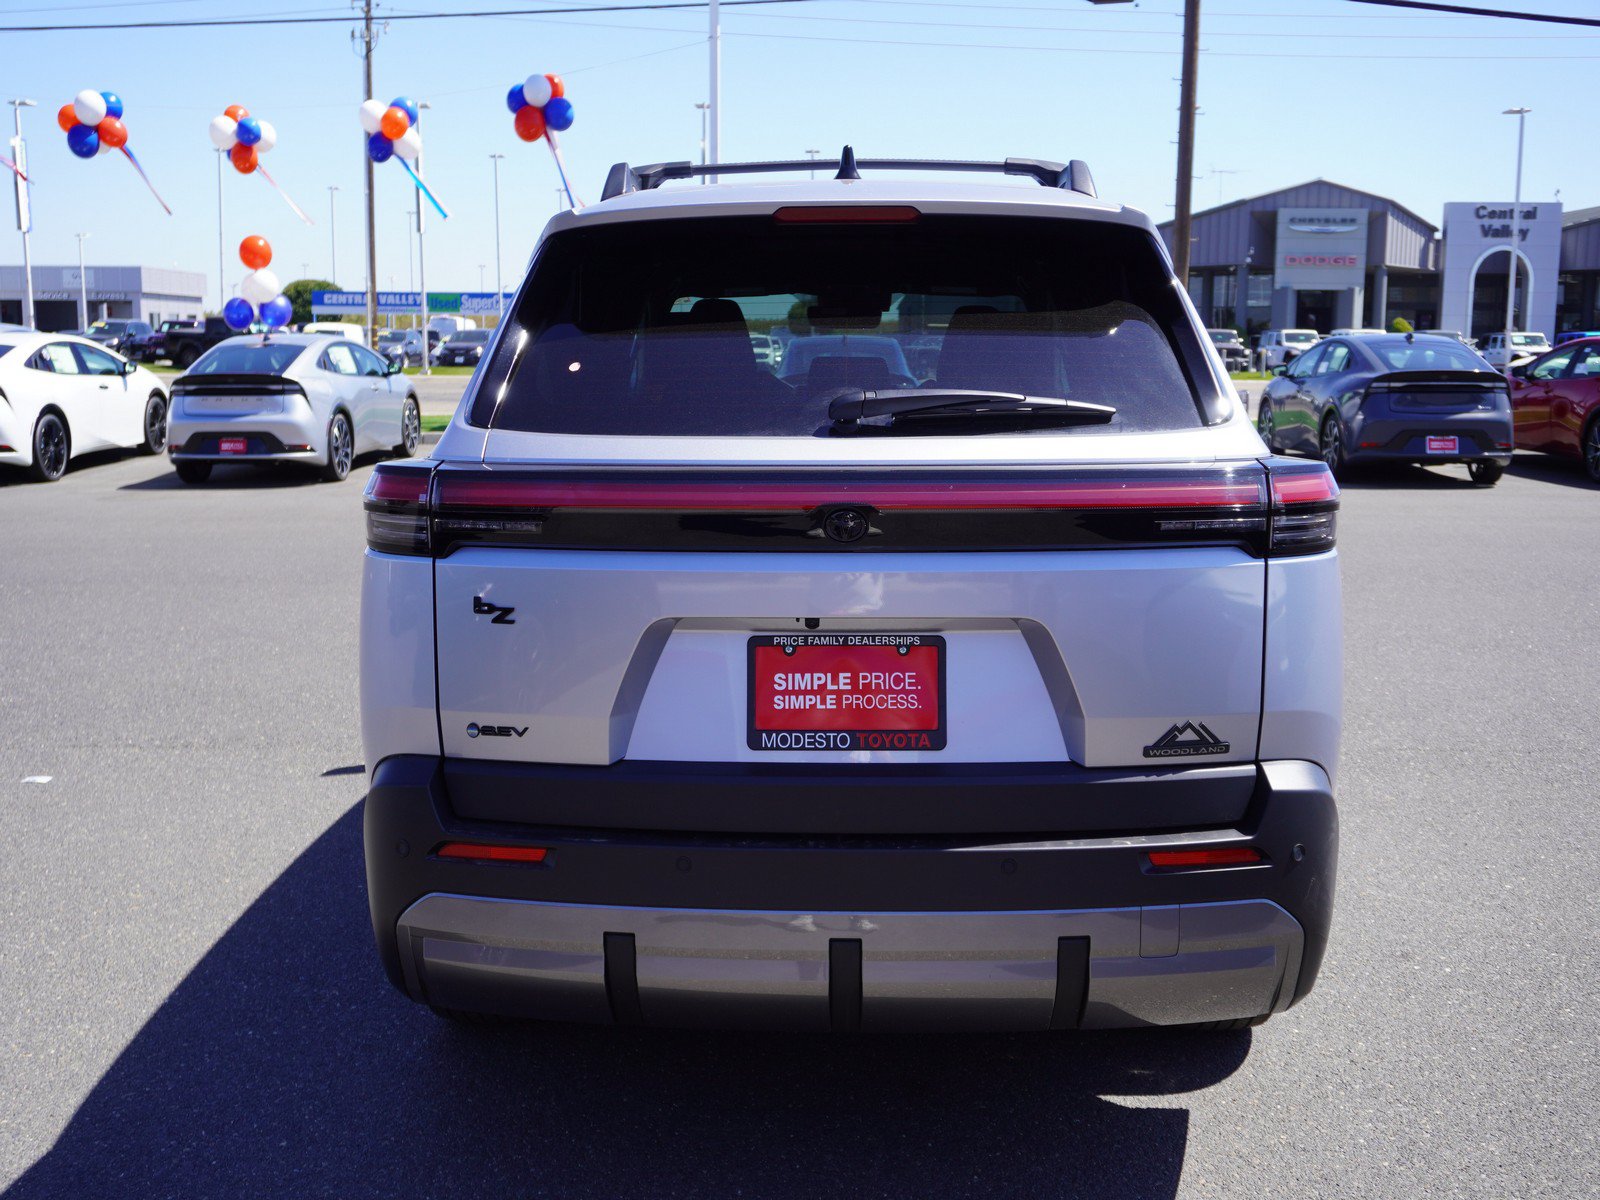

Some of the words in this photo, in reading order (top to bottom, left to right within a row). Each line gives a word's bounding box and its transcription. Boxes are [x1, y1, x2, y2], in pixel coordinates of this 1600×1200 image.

[1480, 224, 1530, 242] Vally
[1285, 256, 1357, 267] DODGE
[323, 293, 368, 305] CENTRA
[379, 294, 422, 305] VALLEY
[773, 636, 804, 645] PRICE
[807, 636, 844, 645] FAMILY
[848, 636, 920, 645] DEALERSHIPS
[773, 672, 851, 690] SIMPLE
[859, 672, 922, 690] PRICE.
[773, 695, 836, 709] SIMPLE
[842, 694, 922, 709] PROCESS.
[762, 733, 850, 748] MODESTO
[857, 733, 931, 748] TOYOTA
[1149, 746, 1226, 756] WOODLAND
